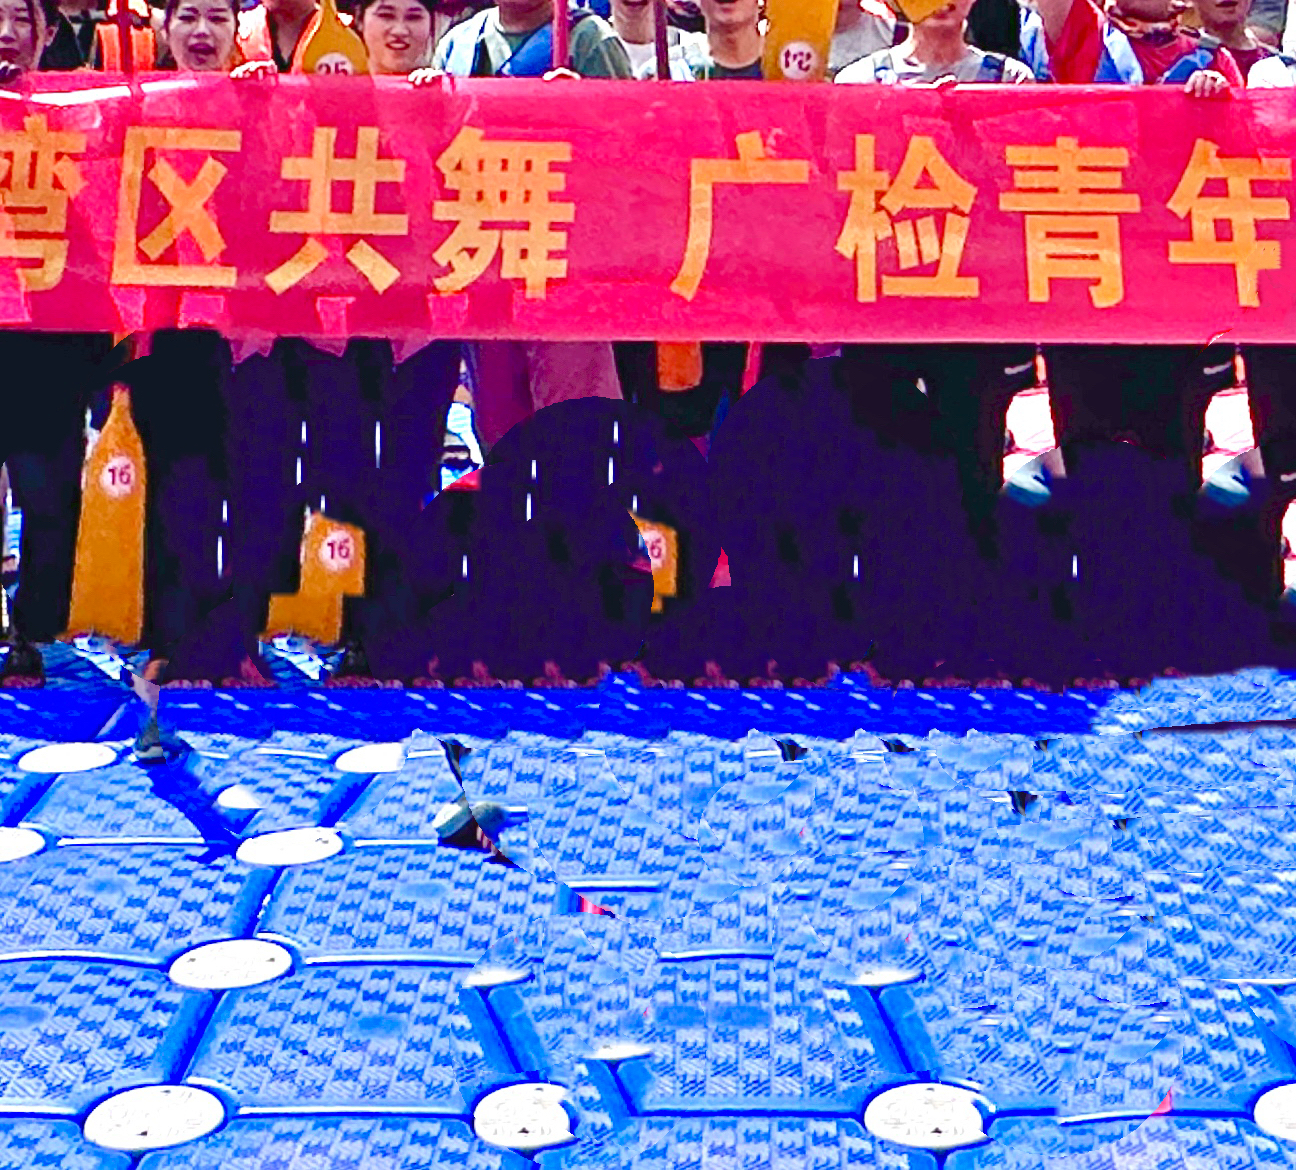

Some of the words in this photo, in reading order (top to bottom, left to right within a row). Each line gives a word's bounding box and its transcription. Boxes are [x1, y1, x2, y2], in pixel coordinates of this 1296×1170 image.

[108, 463, 131, 485] 16
[327, 538, 350, 560] 16
[645, 538, 662, 559] 6
